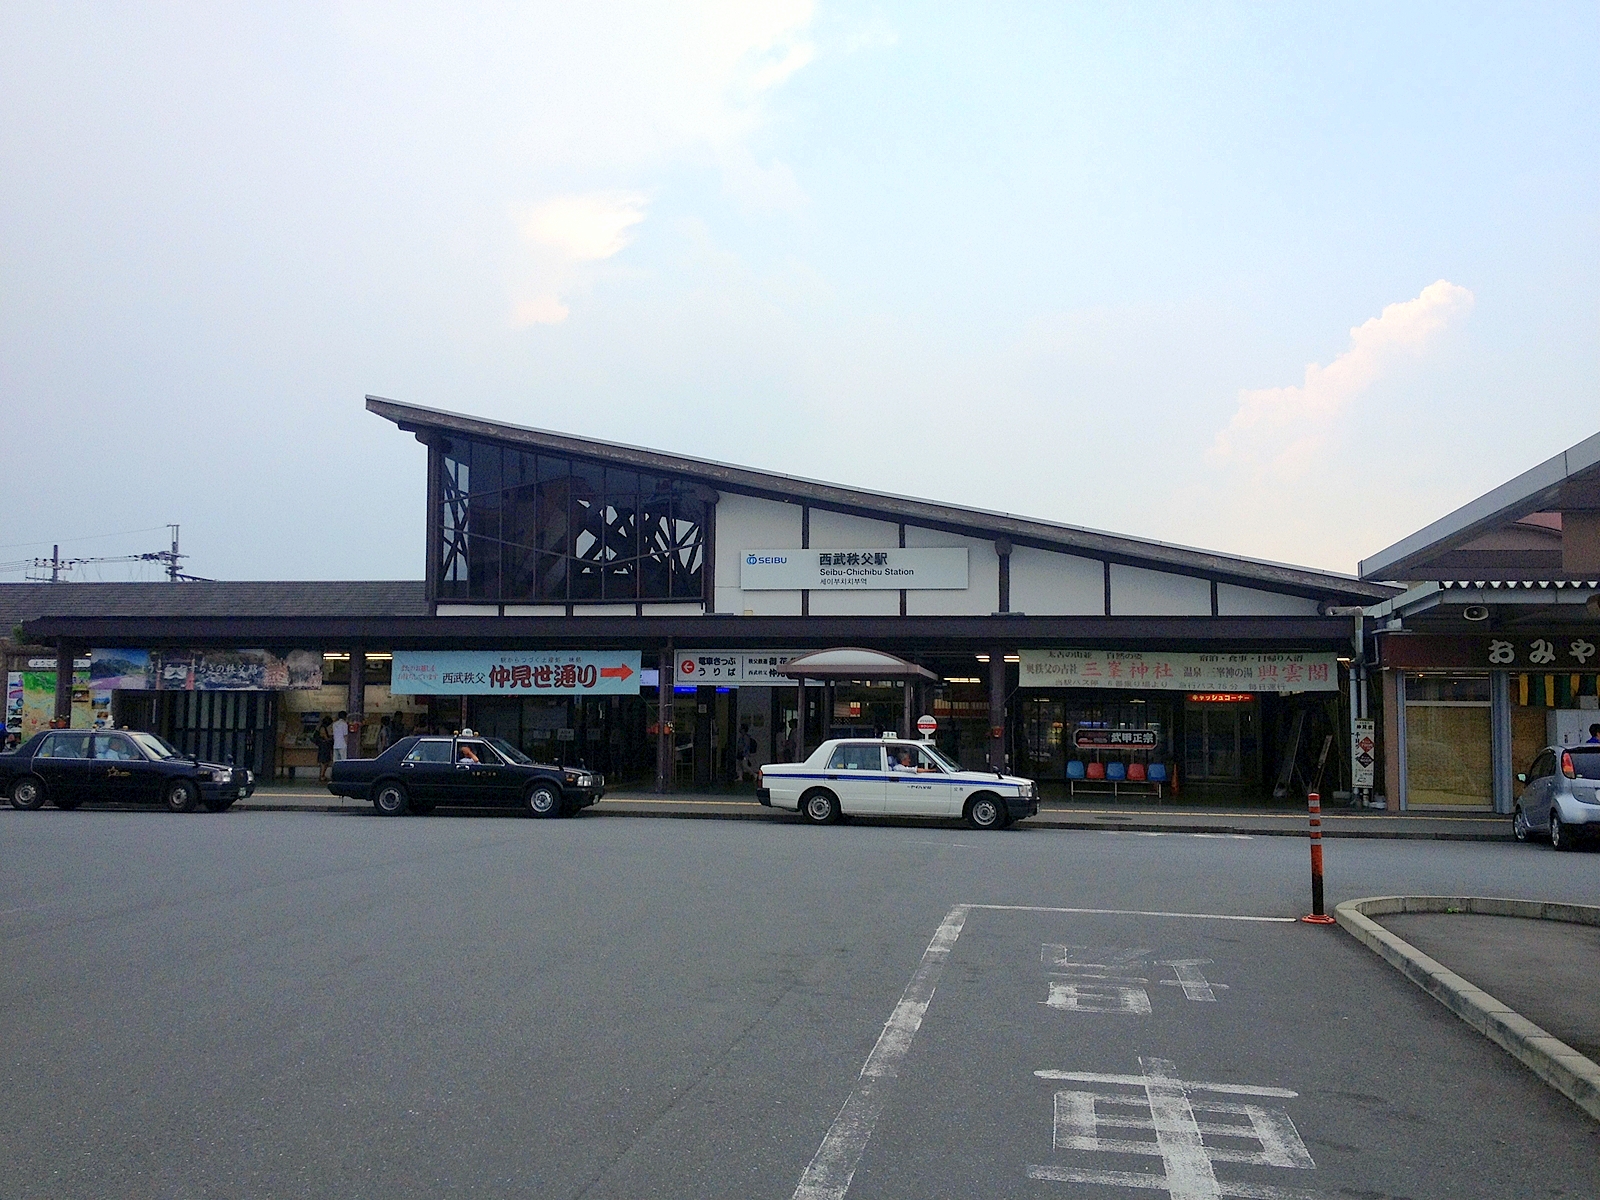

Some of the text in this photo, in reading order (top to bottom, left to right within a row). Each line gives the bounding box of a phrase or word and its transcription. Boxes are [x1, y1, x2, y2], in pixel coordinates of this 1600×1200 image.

[758, 556, 788, 564] SEIBU
[819, 552, 888, 566] 西武秩父駅
[819, 568, 914, 576] Seibu-Chichibu Station
[1488, 638, 1596, 664] おみや
[442, 664, 598, 689] 西武秩父 仲見世通り
[698, 667, 737, 676] うりば
[1026, 663, 1078, 675] 奥秩父の古社
[1080, 660, 1174, 680] 三峯神社
[1183, 666, 1202, 678] 温泉
[1258, 663, 1329, 683] 興雲閣
[1191, 693, 1251, 702] キャッシュコーナー
[1111, 732, 1154, 744] 武甲正宗
